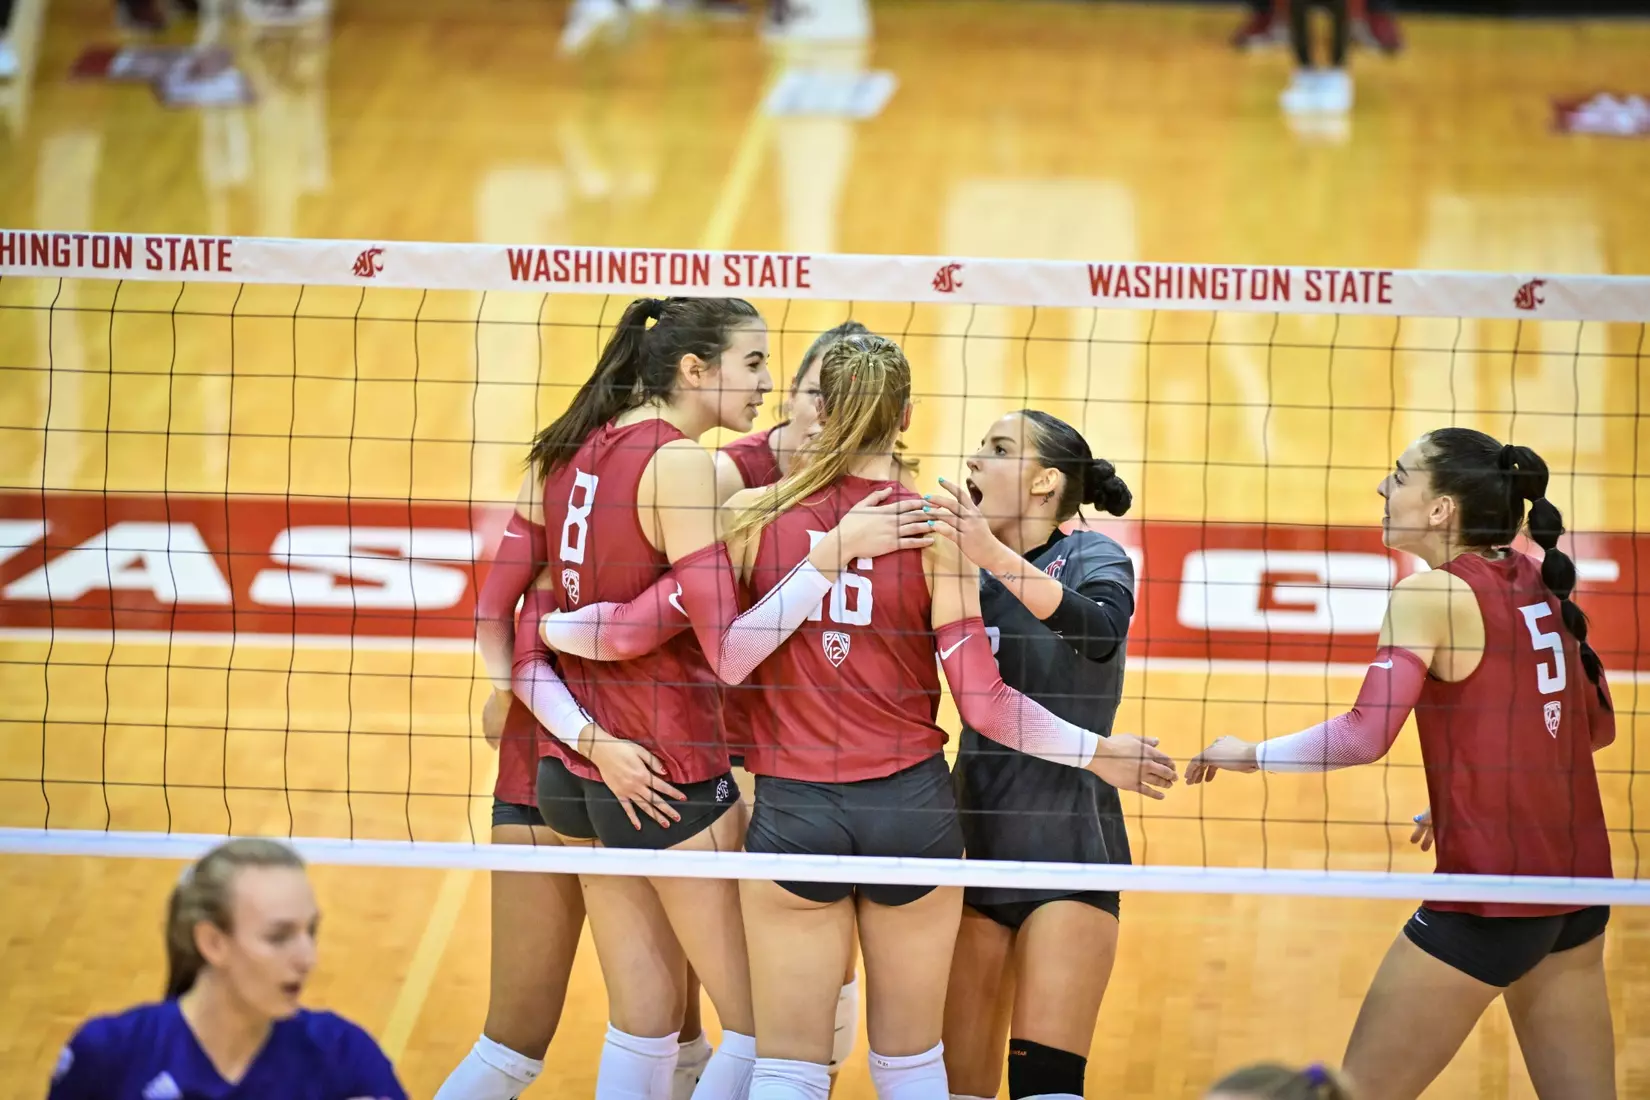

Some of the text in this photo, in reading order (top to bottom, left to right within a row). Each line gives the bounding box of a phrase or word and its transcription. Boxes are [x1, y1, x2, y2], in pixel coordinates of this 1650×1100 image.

[145, 237, 233, 272] STATE
[507, 248, 811, 288] WASHINGTON STATE
[1087, 264, 1393, 303] WASHINGTON STATE
[559, 468, 599, 565] 8
[824, 632, 849, 653] PAC
[829, 646, 843, 660] 12
[1517, 601, 1567, 695] 5
